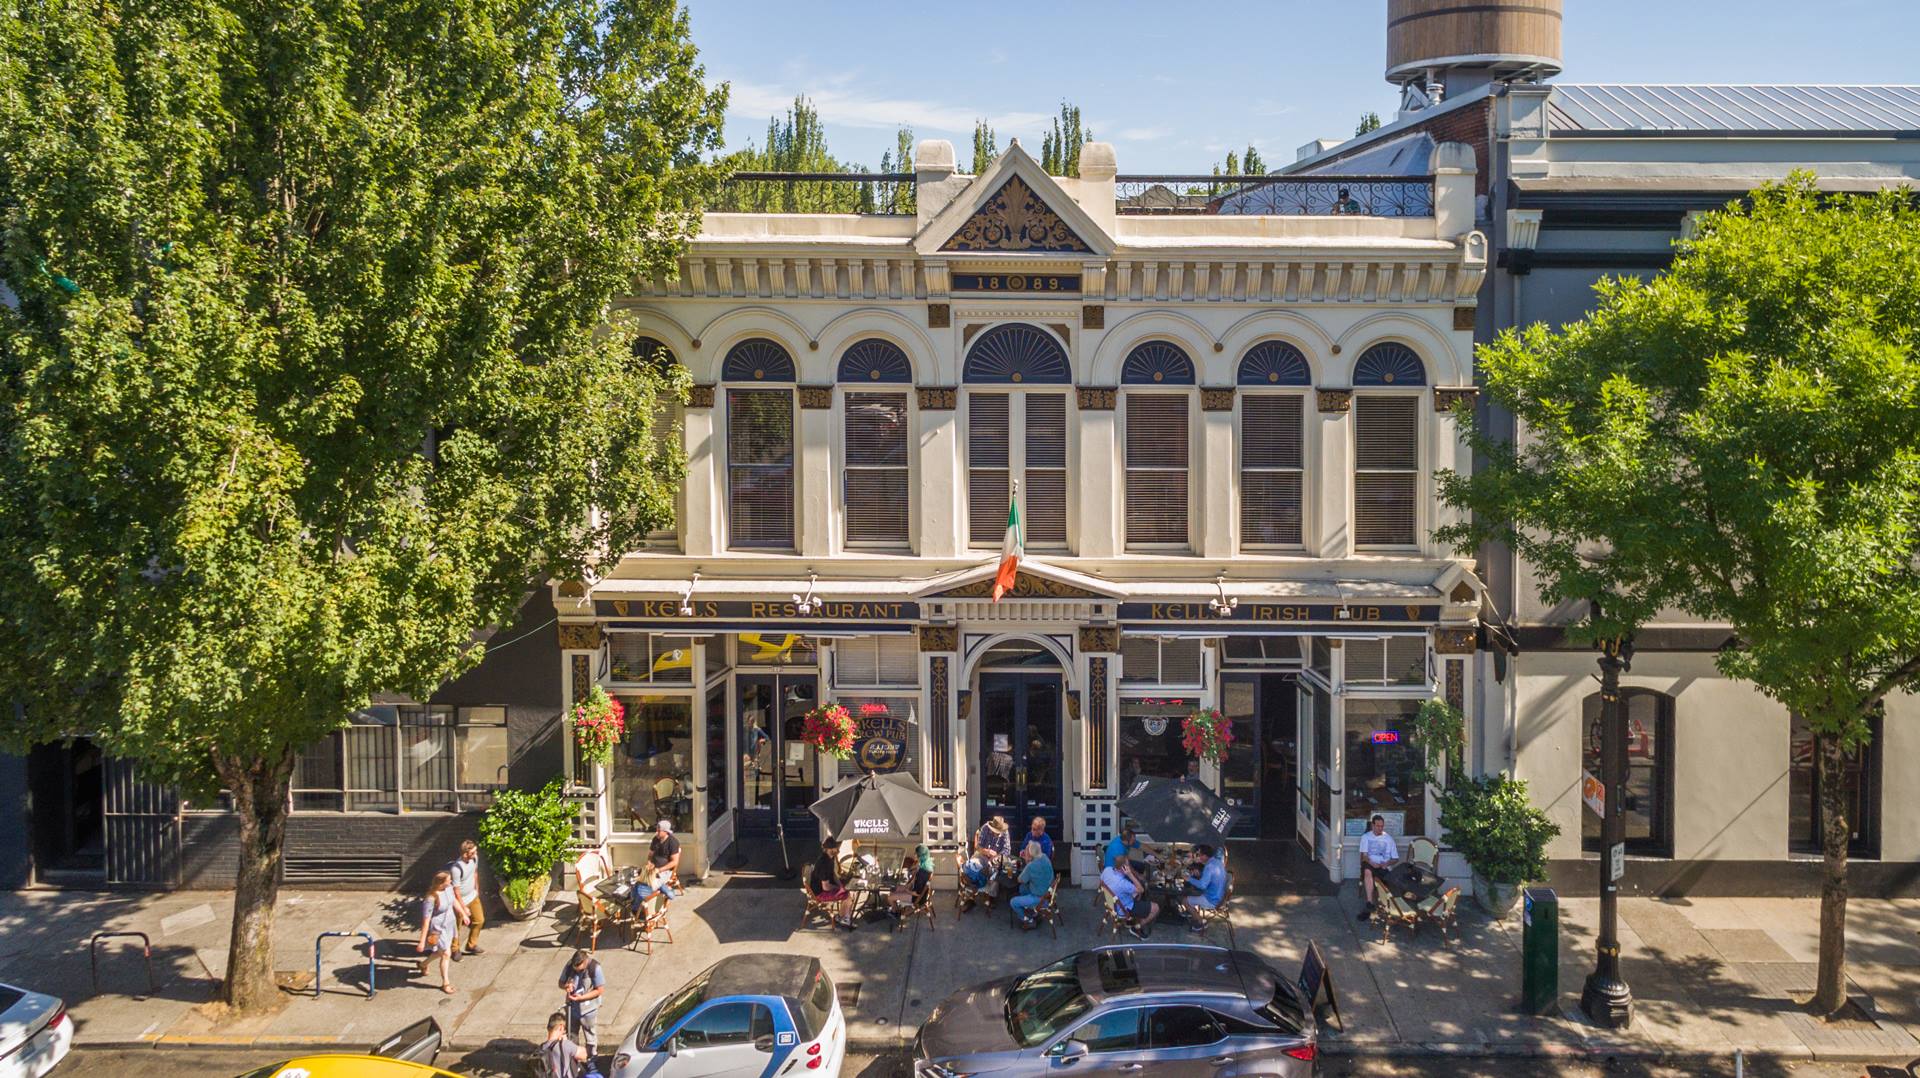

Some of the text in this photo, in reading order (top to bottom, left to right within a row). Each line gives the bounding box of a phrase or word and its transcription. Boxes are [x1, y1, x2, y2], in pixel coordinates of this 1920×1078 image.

[978, 277, 999, 289] 18
[751, 601, 903, 618] RESAURANT
[1252, 604, 1310, 620] IRISH
[862, 718, 905, 731] KELLS
[860, 818, 889, 827] KELLS
